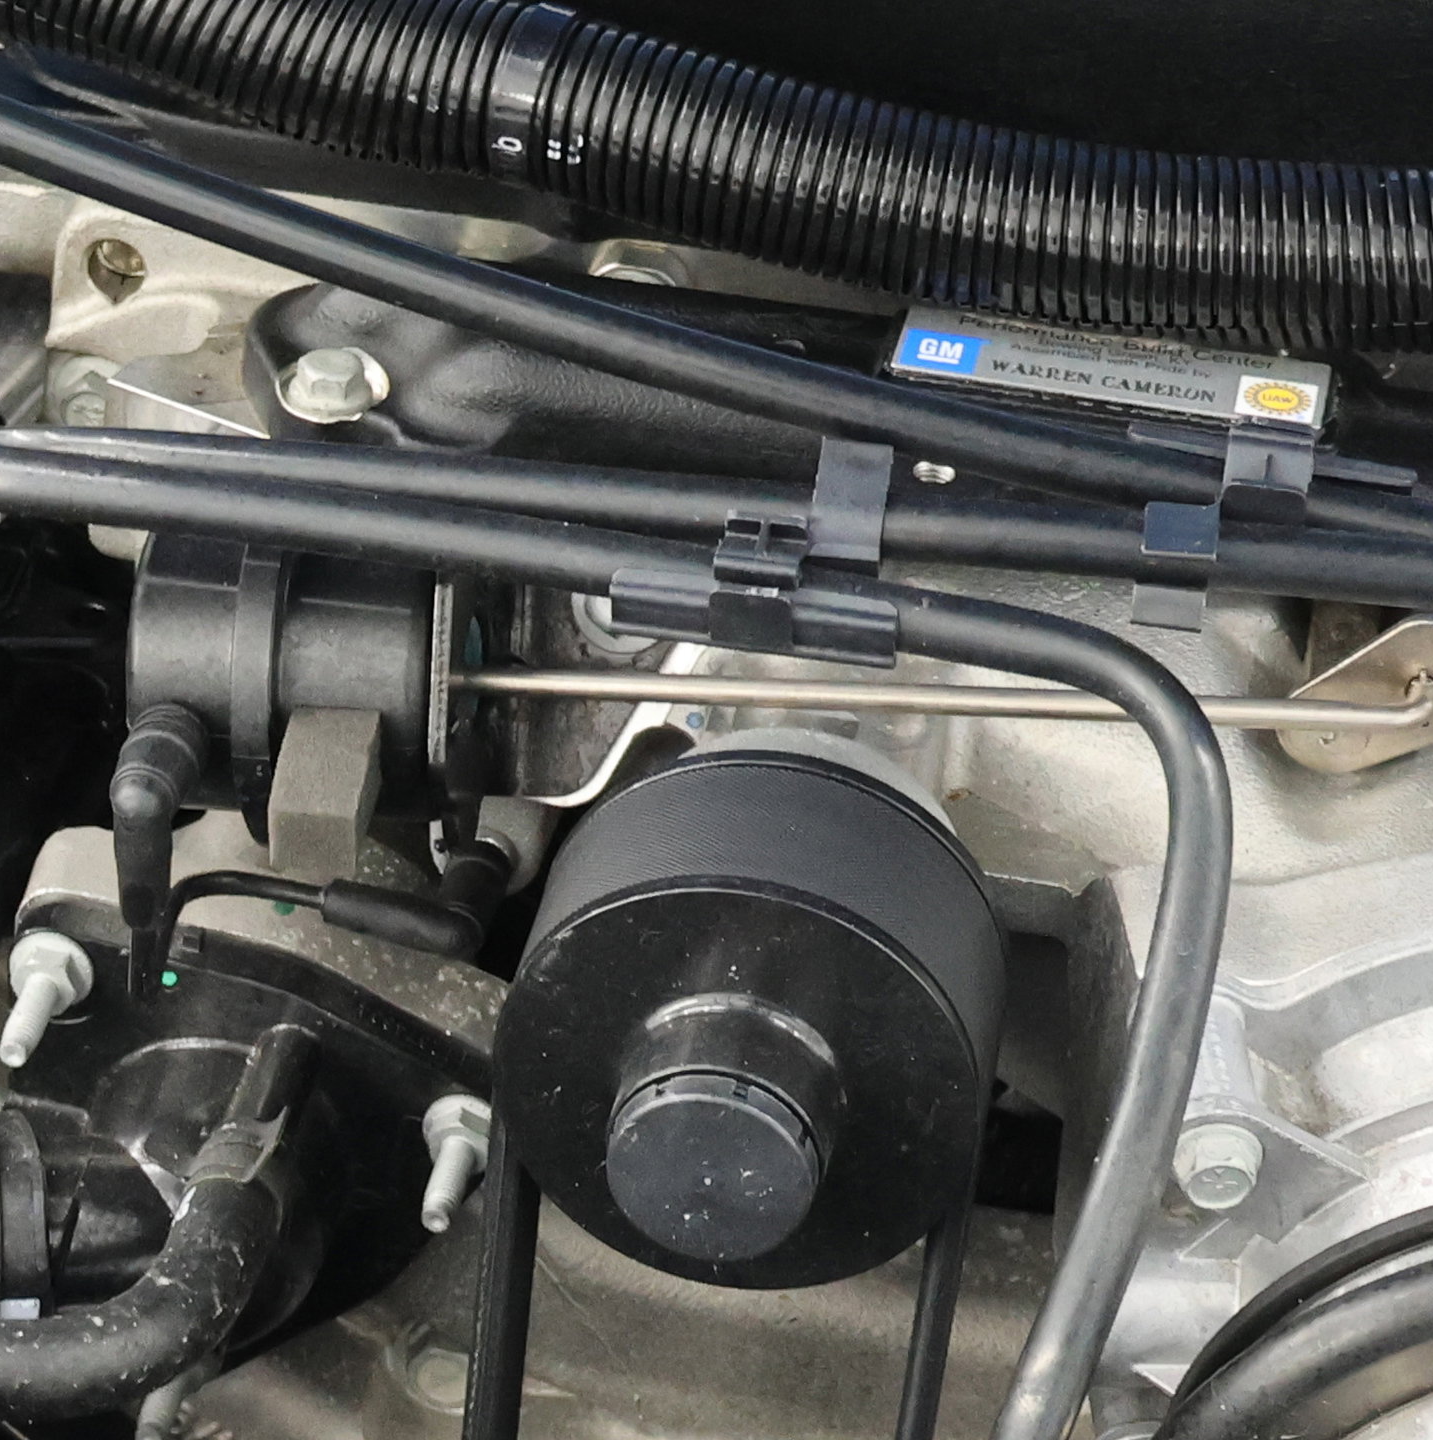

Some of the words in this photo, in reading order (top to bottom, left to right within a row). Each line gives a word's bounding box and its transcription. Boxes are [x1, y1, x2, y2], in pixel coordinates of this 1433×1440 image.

[917, 337, 964, 360] GM
[1192, 349, 1274, 370] Center
[991, 359, 1094, 386] WARREN
[1101, 374, 1217, 404] CAMERON
[1262, 392, 1295, 405] UAW
